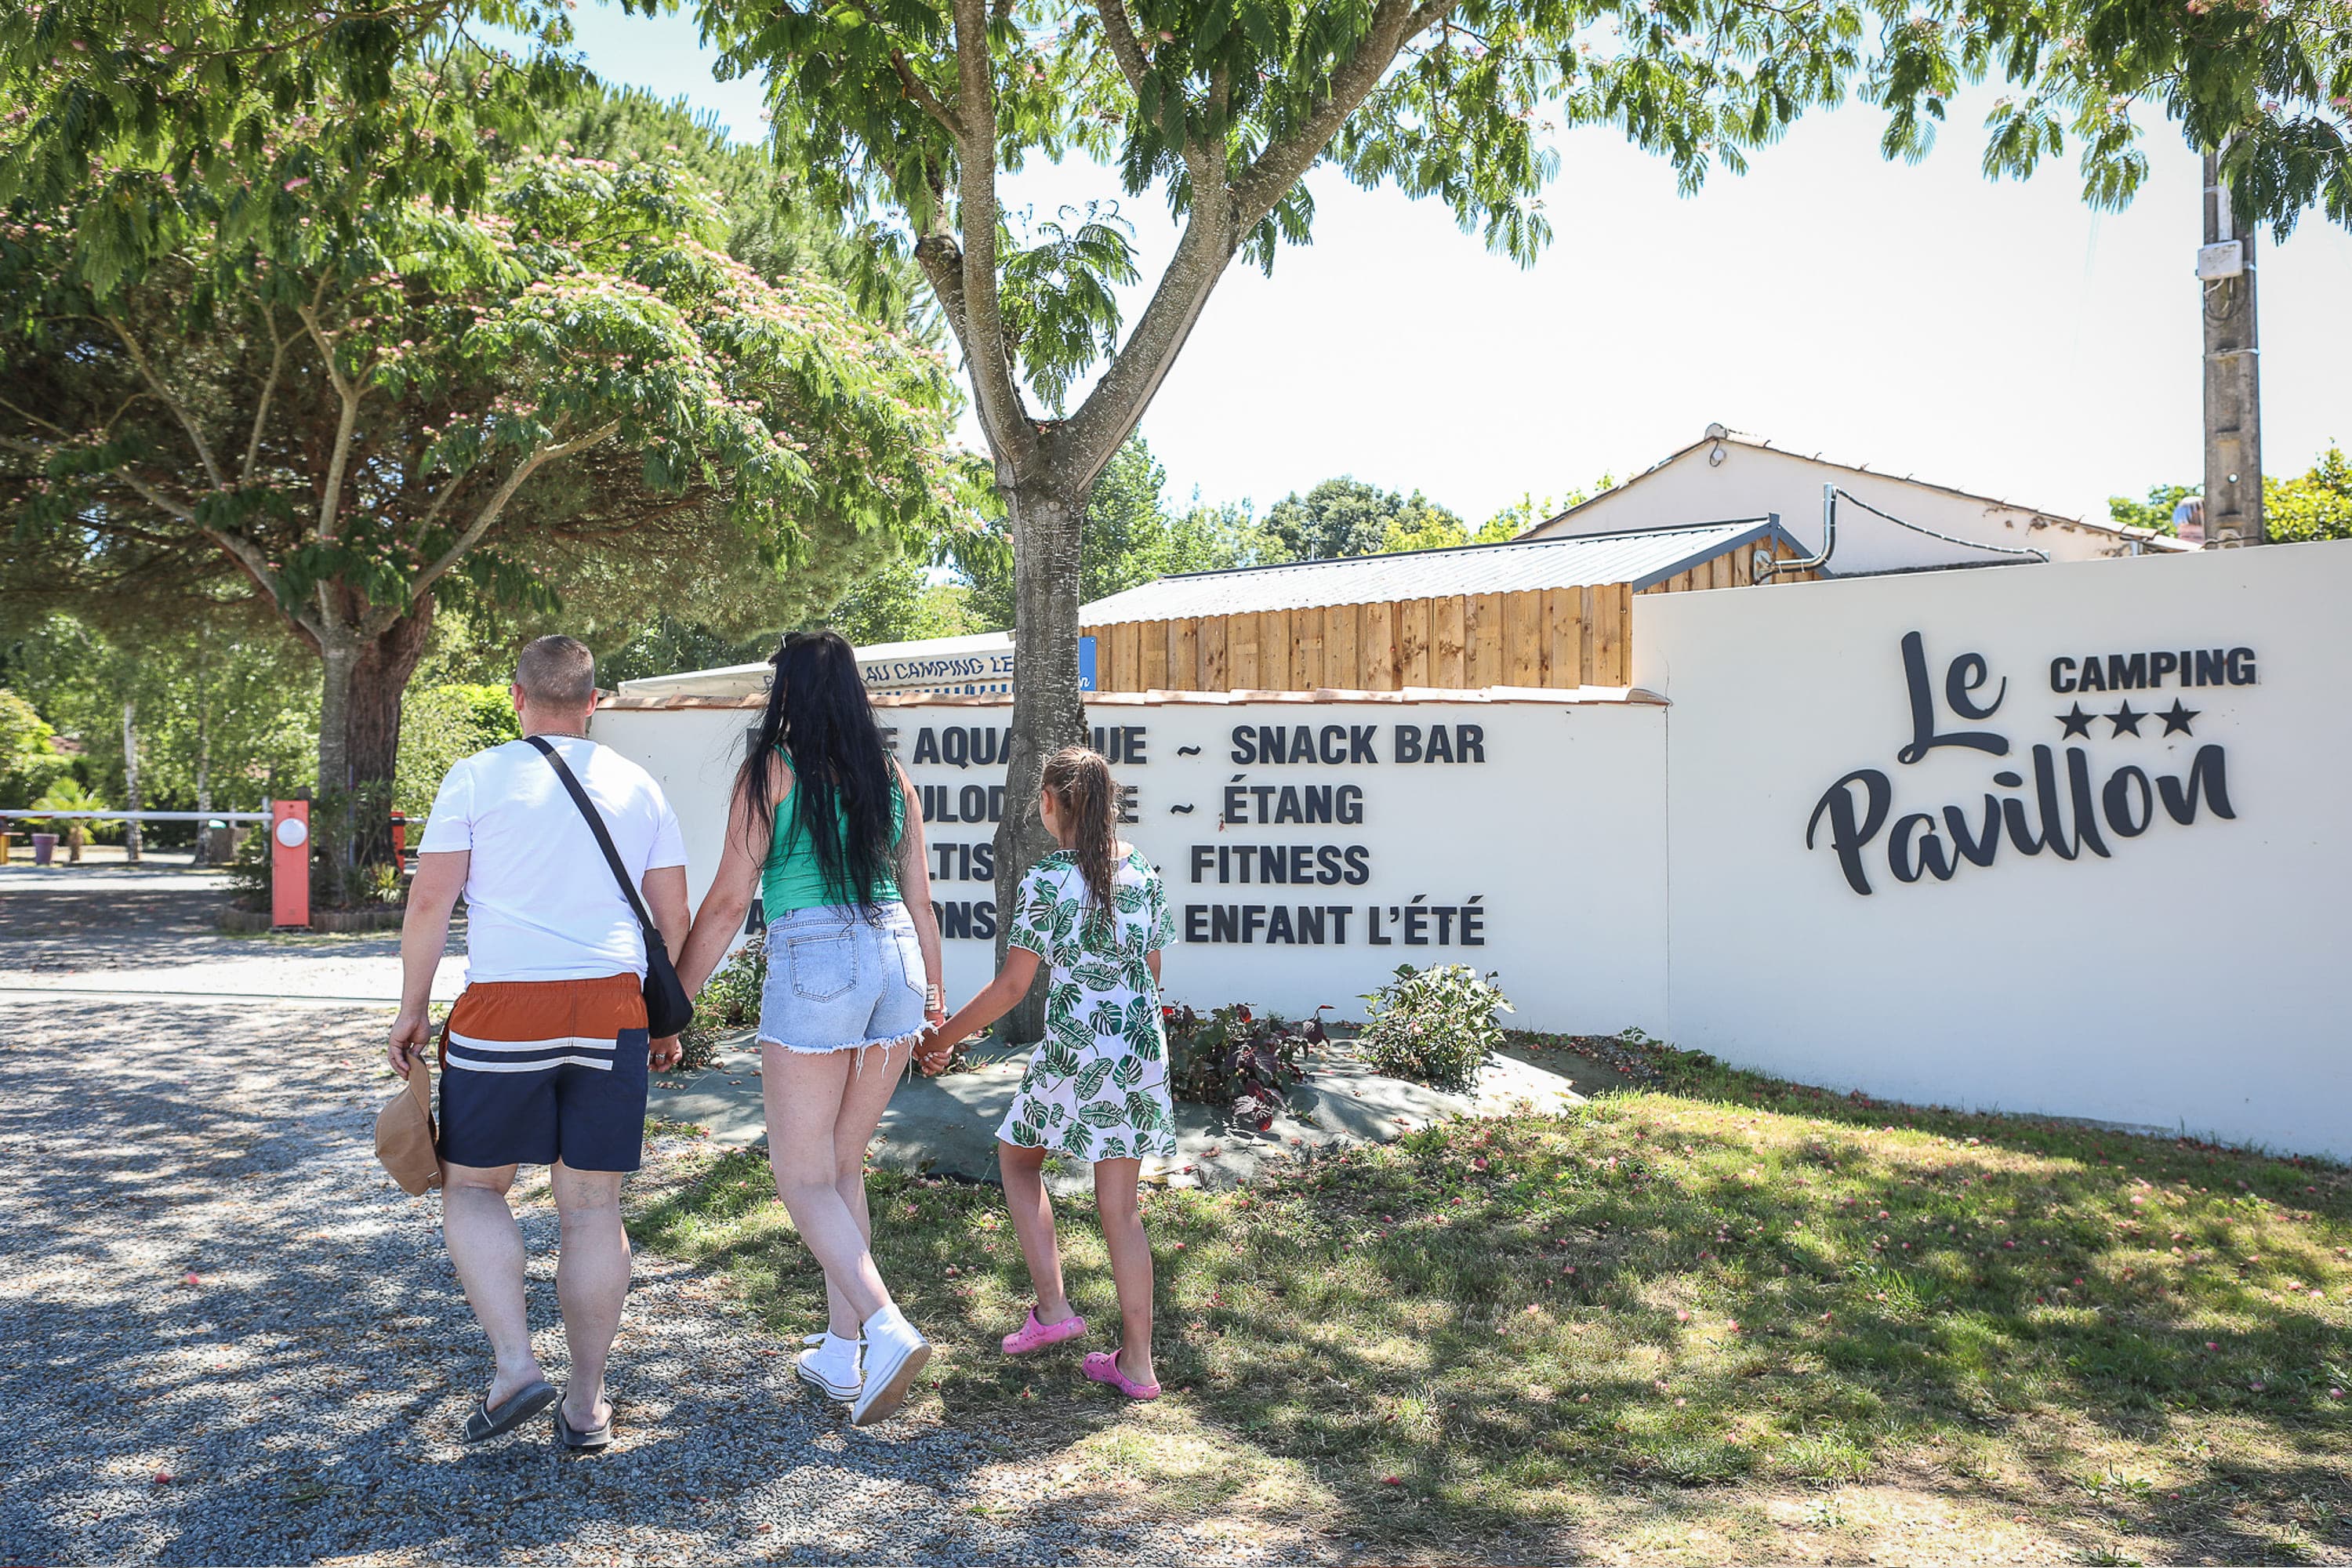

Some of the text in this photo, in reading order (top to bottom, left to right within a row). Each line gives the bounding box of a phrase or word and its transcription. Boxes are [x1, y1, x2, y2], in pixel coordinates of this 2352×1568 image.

[866, 664, 890, 682] AU
[894, 658, 984, 680] CAMPING
[2050, 648, 2256, 694] CAMPING
[1898, 631, 2009, 764] Le
[1231, 725, 1379, 764] SNACK
[1395, 724, 1486, 764] BAR
[1224, 774, 1363, 824] ÉTANG
[1806, 744, 2237, 895] Pavillon
[1191, 845, 1370, 885] FITNESS
[1185, 894, 1485, 946] ENFANT L'ÉTÉ
